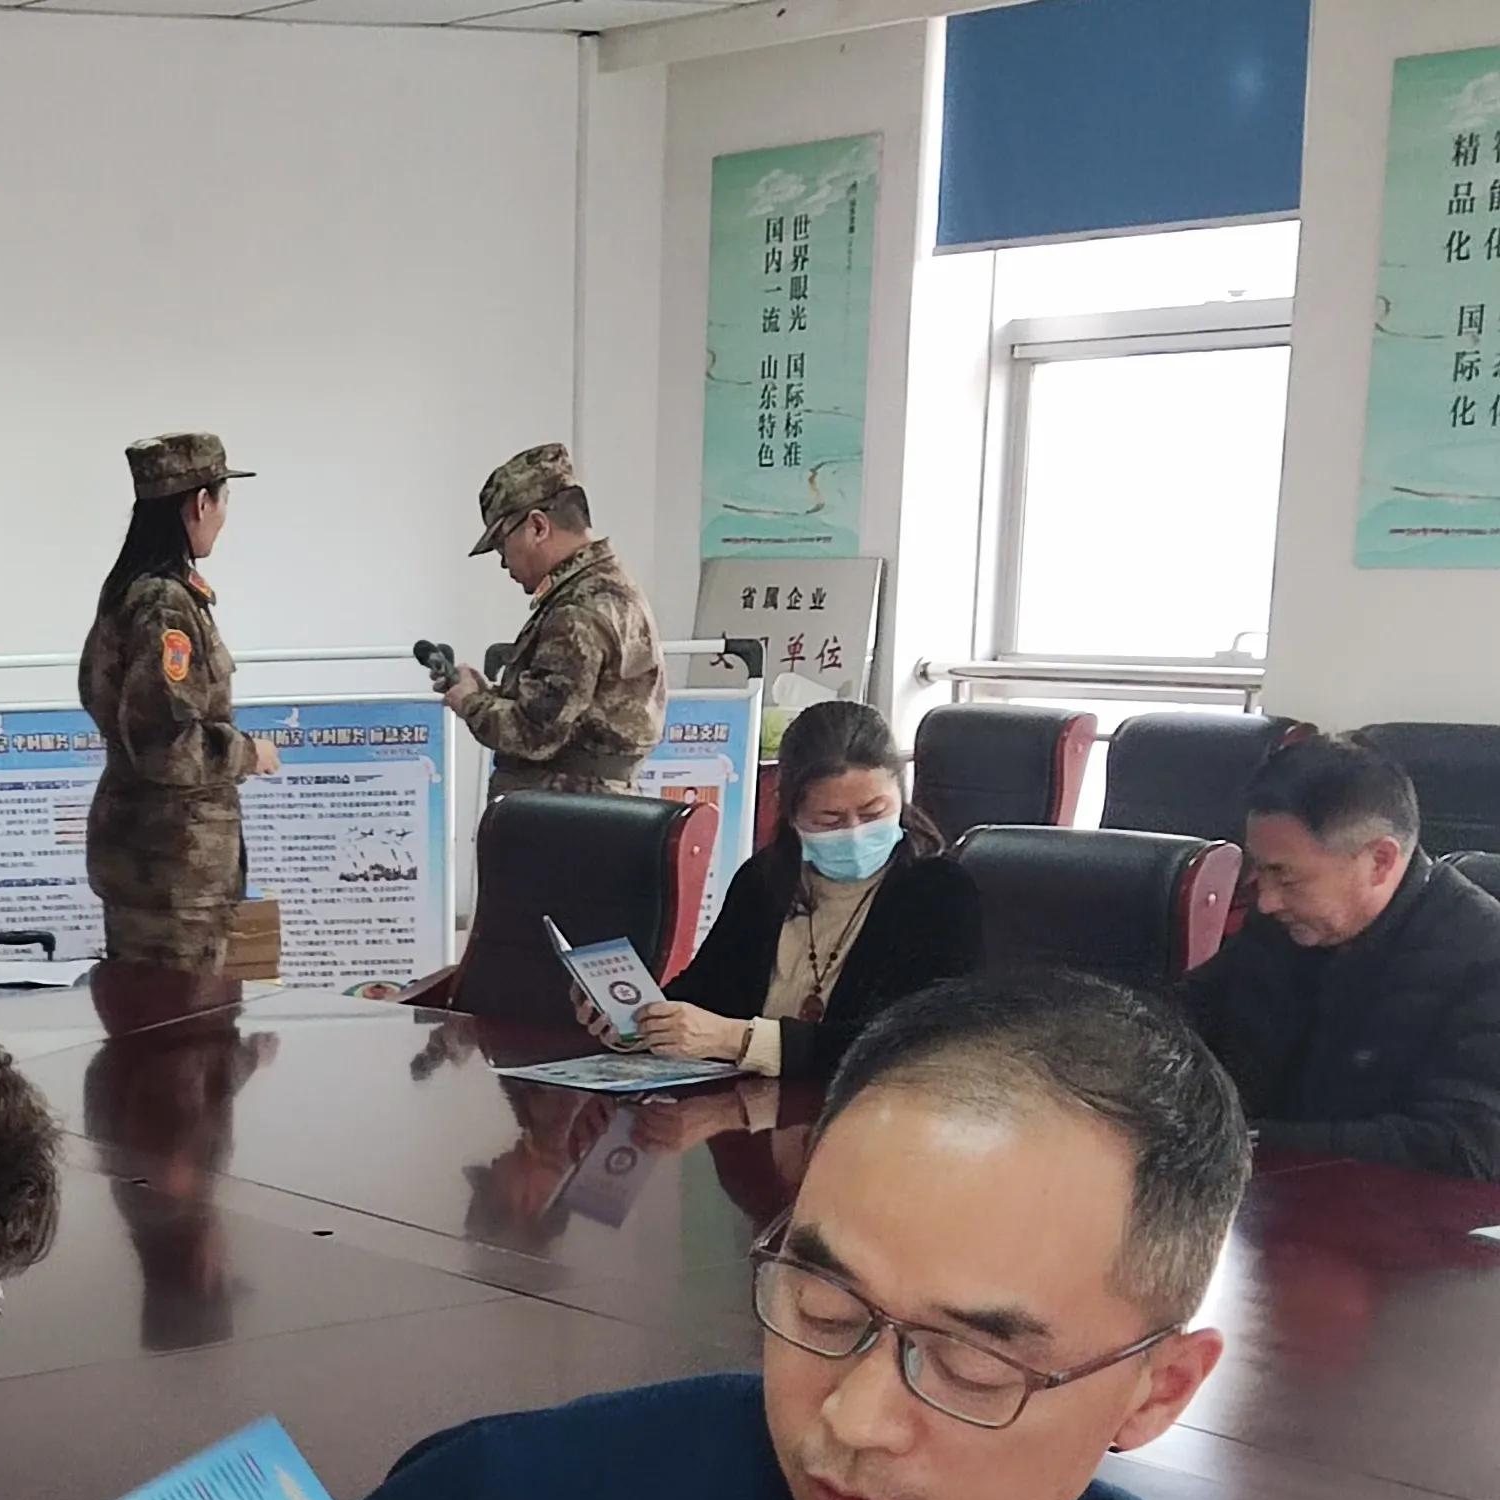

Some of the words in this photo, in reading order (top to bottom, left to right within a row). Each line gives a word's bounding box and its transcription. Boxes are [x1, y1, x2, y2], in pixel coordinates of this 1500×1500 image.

[1445, 132, 1481, 263] 精品化
[762, 216, 784, 334] 国内一流
[789, 213, 812, 333] 世界眼光
[757, 354, 778, 468] 山东特色
[783, 352, 805, 467] 国际标准
[1451, 303, 1485, 428] 国际化
[741, 586, 827, 610] 省属企业
